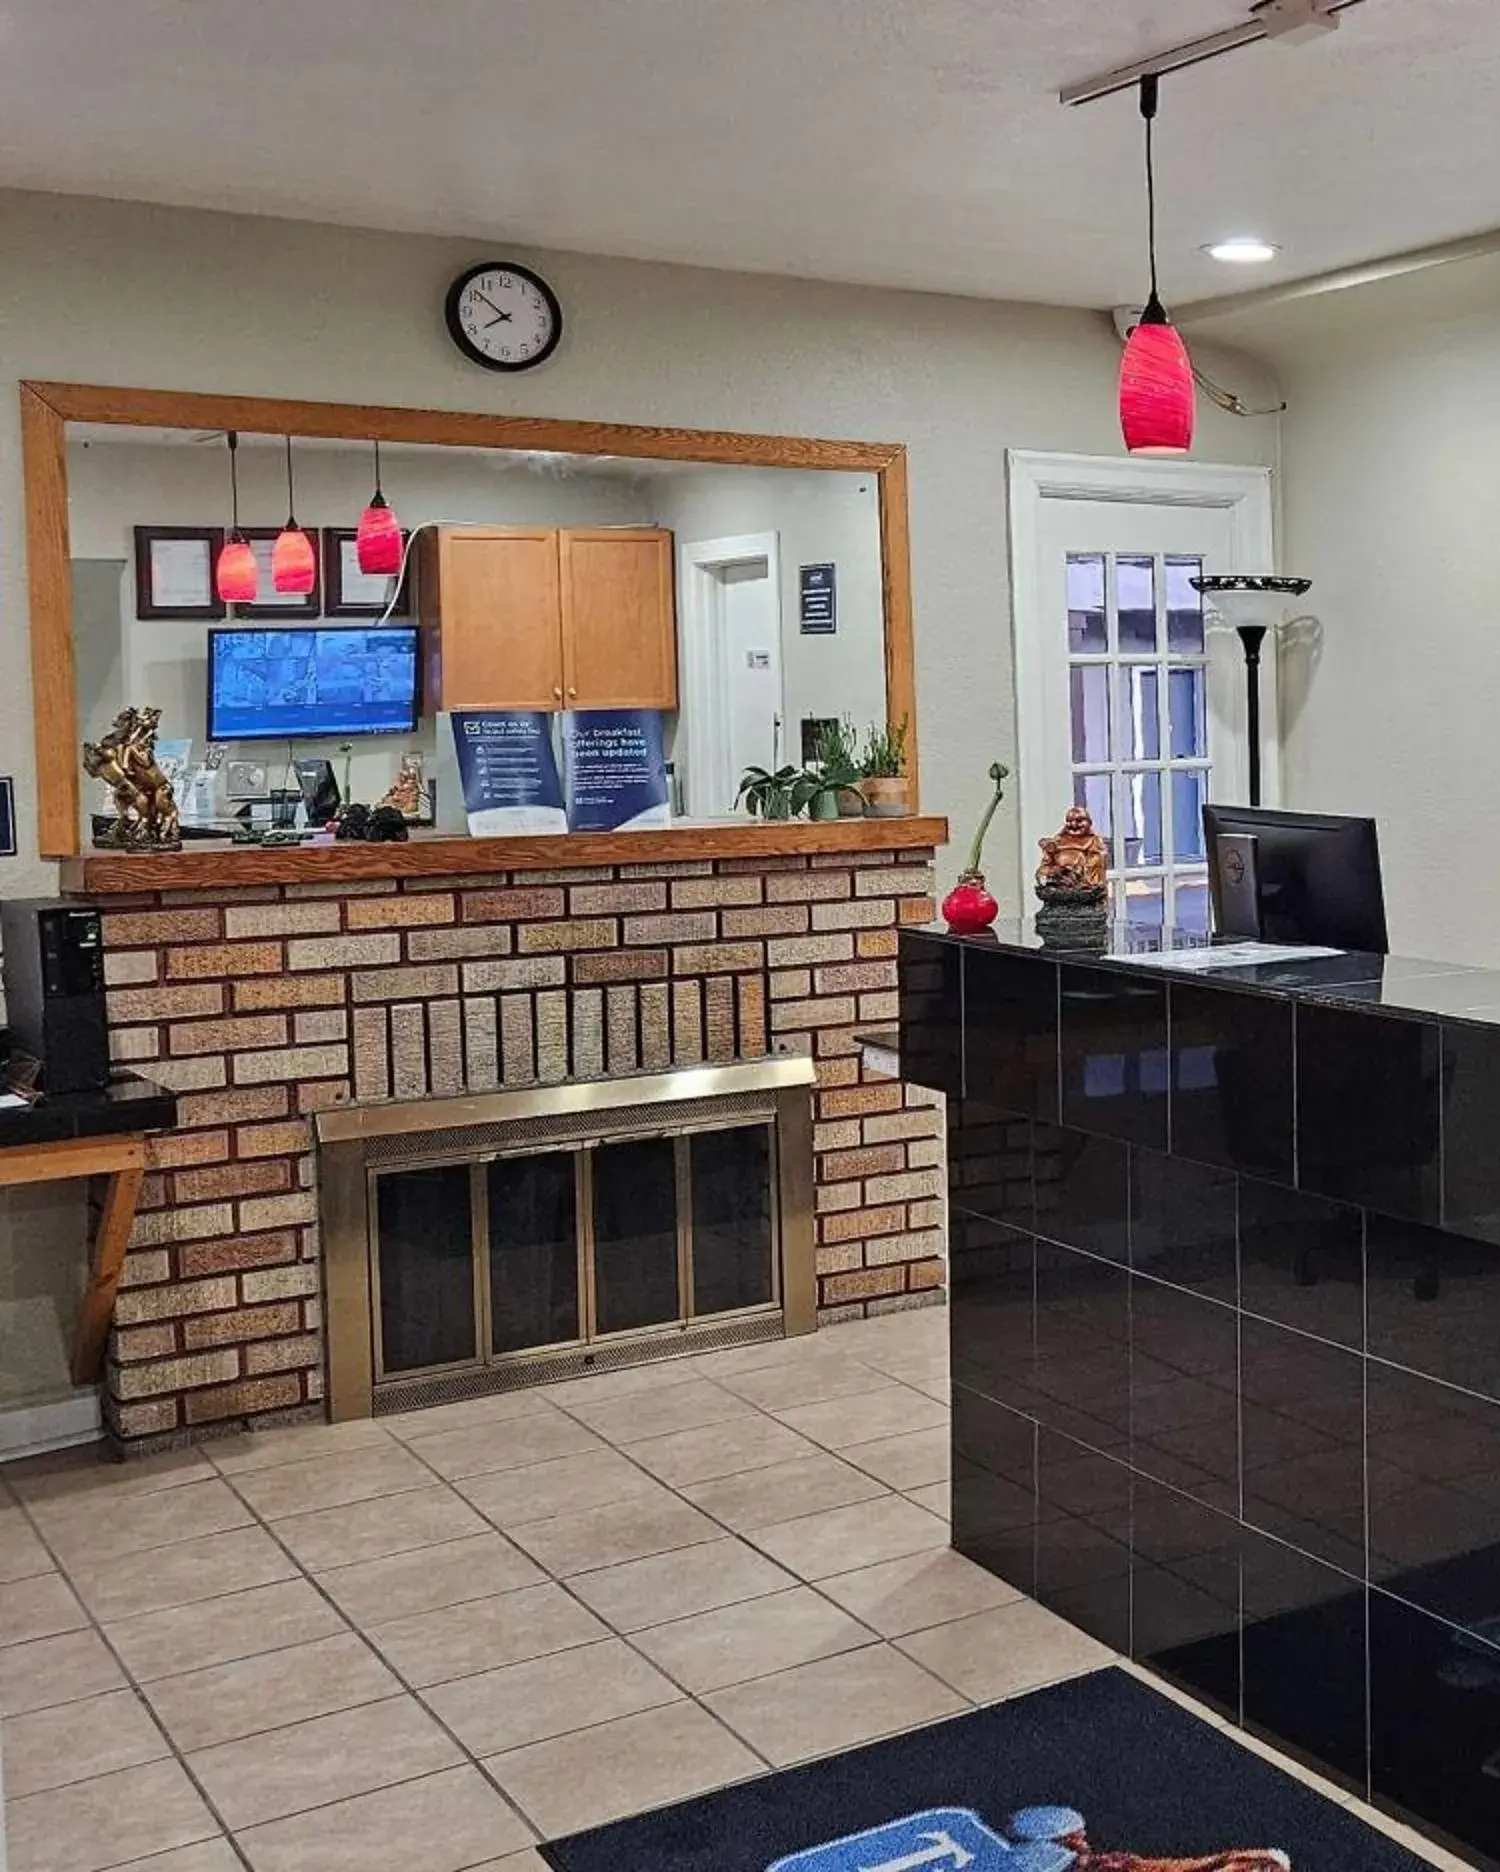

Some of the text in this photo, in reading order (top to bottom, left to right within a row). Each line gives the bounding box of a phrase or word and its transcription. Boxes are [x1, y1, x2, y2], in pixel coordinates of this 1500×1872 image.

[481, 275, 492, 291] 11
[499, 275, 513, 289] 12
[521, 283, 526, 295] 1
[593, 728, 641, 737] breakfast
[620, 738, 647, 748] have
[601, 748, 648, 758] updated
